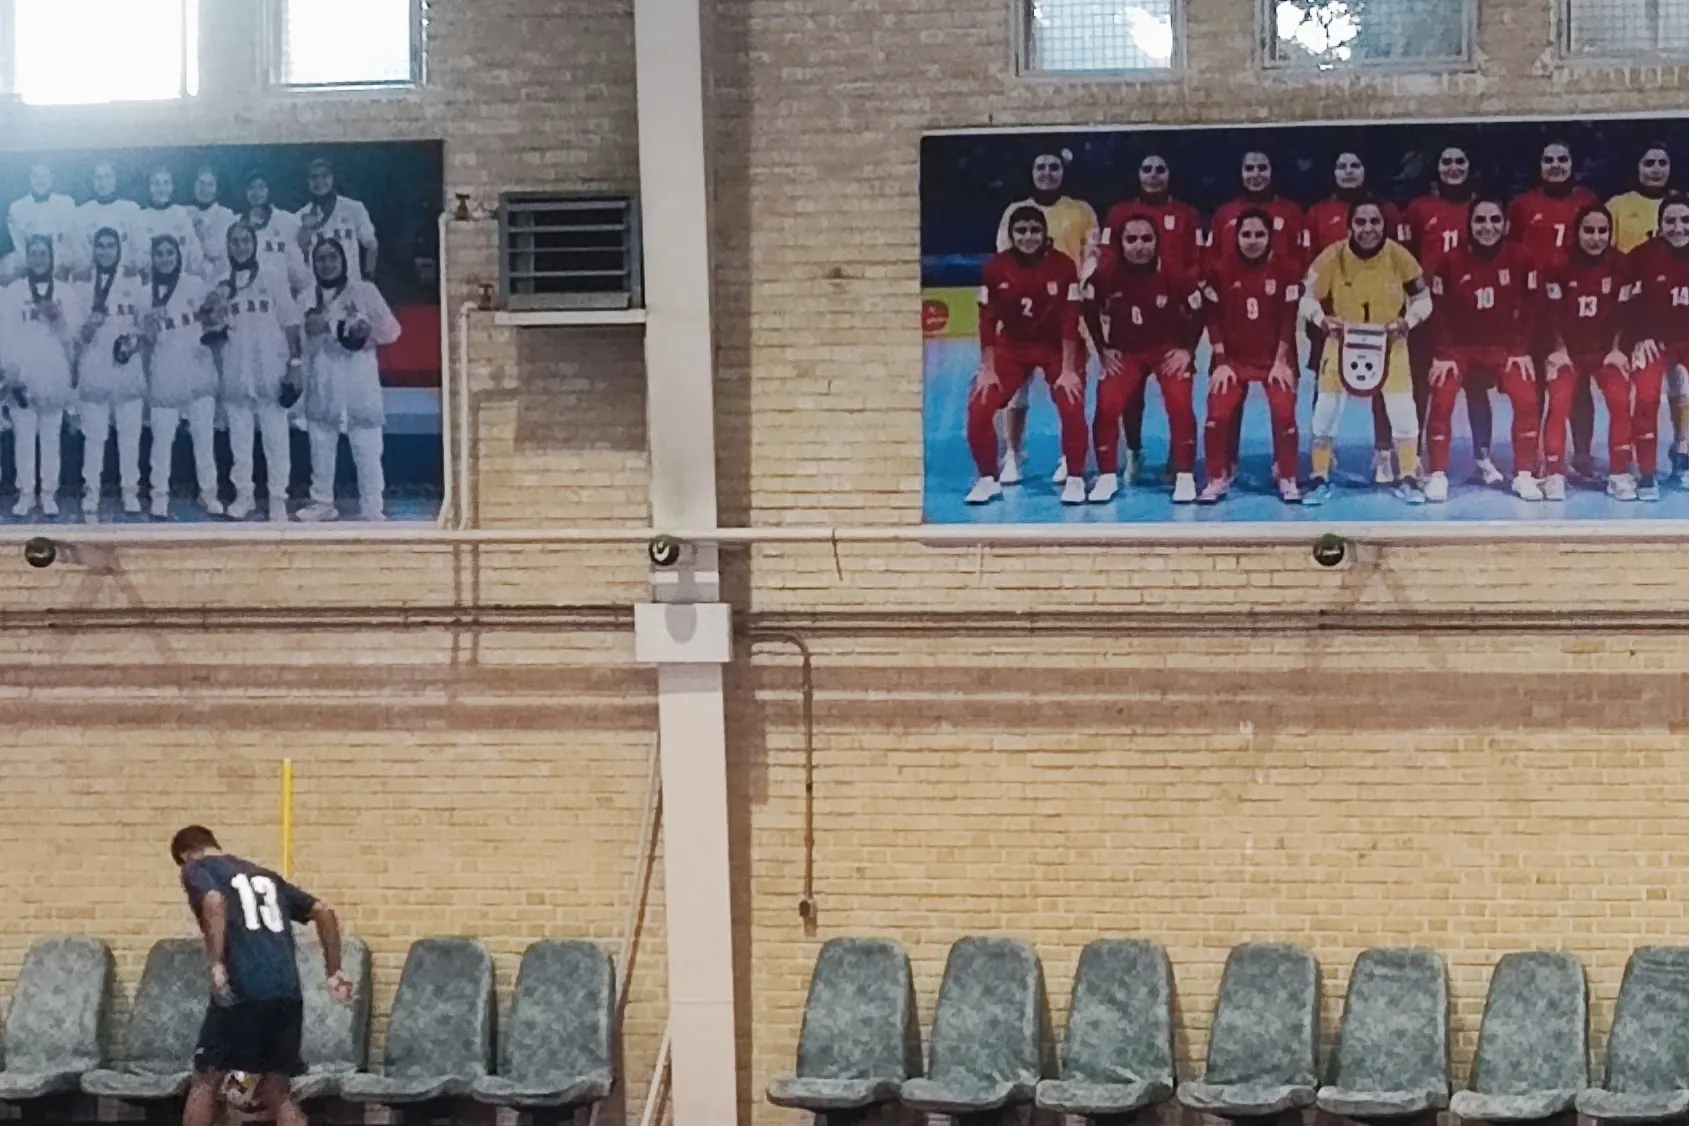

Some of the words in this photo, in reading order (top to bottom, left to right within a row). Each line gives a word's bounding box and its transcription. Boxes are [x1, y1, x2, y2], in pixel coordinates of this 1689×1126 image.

[1442, 229, 1459, 253] 11
[1554, 223, 1566, 247] 7
[1020, 297, 1033, 318] 2
[1474, 286, 1495, 311] 10
[1578, 296, 1598, 318] 13
[1670, 286, 1689, 308] 14
[1361, 302, 1371, 324] 1
[231, 873, 284, 933] 13
